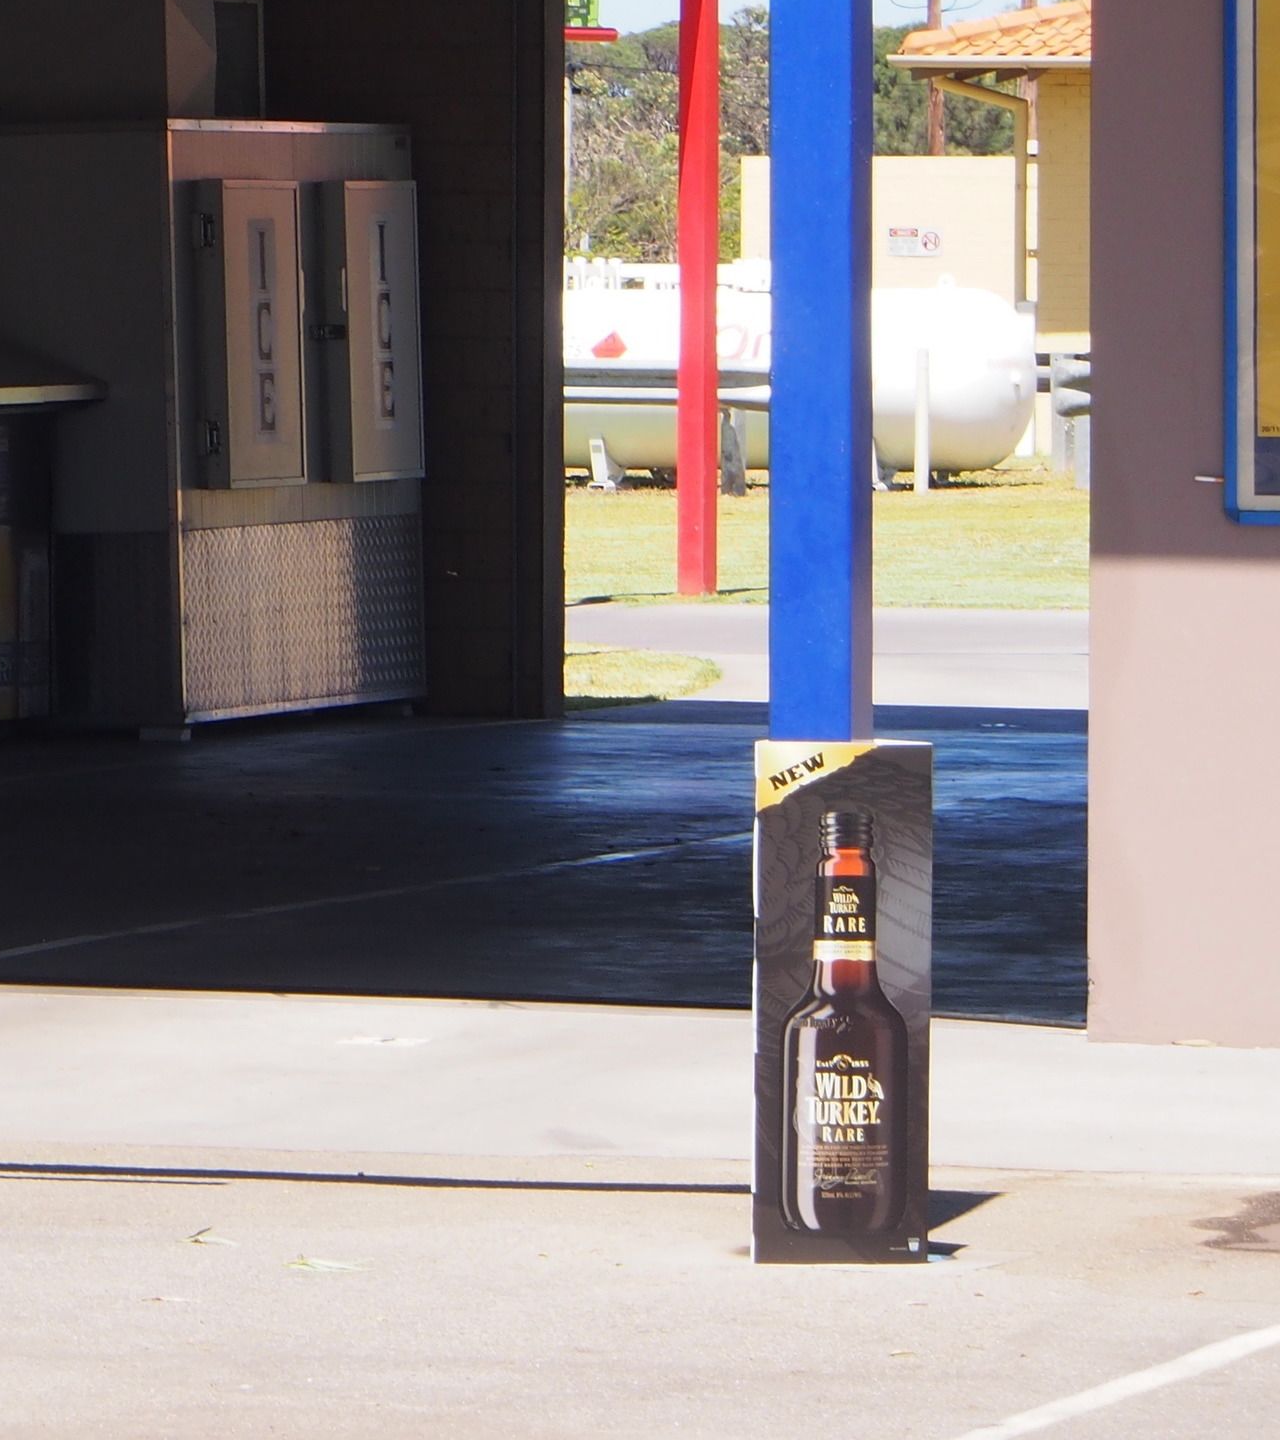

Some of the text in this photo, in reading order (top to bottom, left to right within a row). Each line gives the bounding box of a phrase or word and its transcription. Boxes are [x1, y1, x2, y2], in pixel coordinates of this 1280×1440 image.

[256, 229, 276, 433] ICE
[375, 221, 395, 420] ICE
[768, 752, 825, 791] NEW
[829, 902, 857, 914] TURKEY
[833, 892, 853, 903] WILD
[823, 915, 866, 934] RARE
[815, 1072, 868, 1099] WILD
[822, 1126, 865, 1143] RARE
